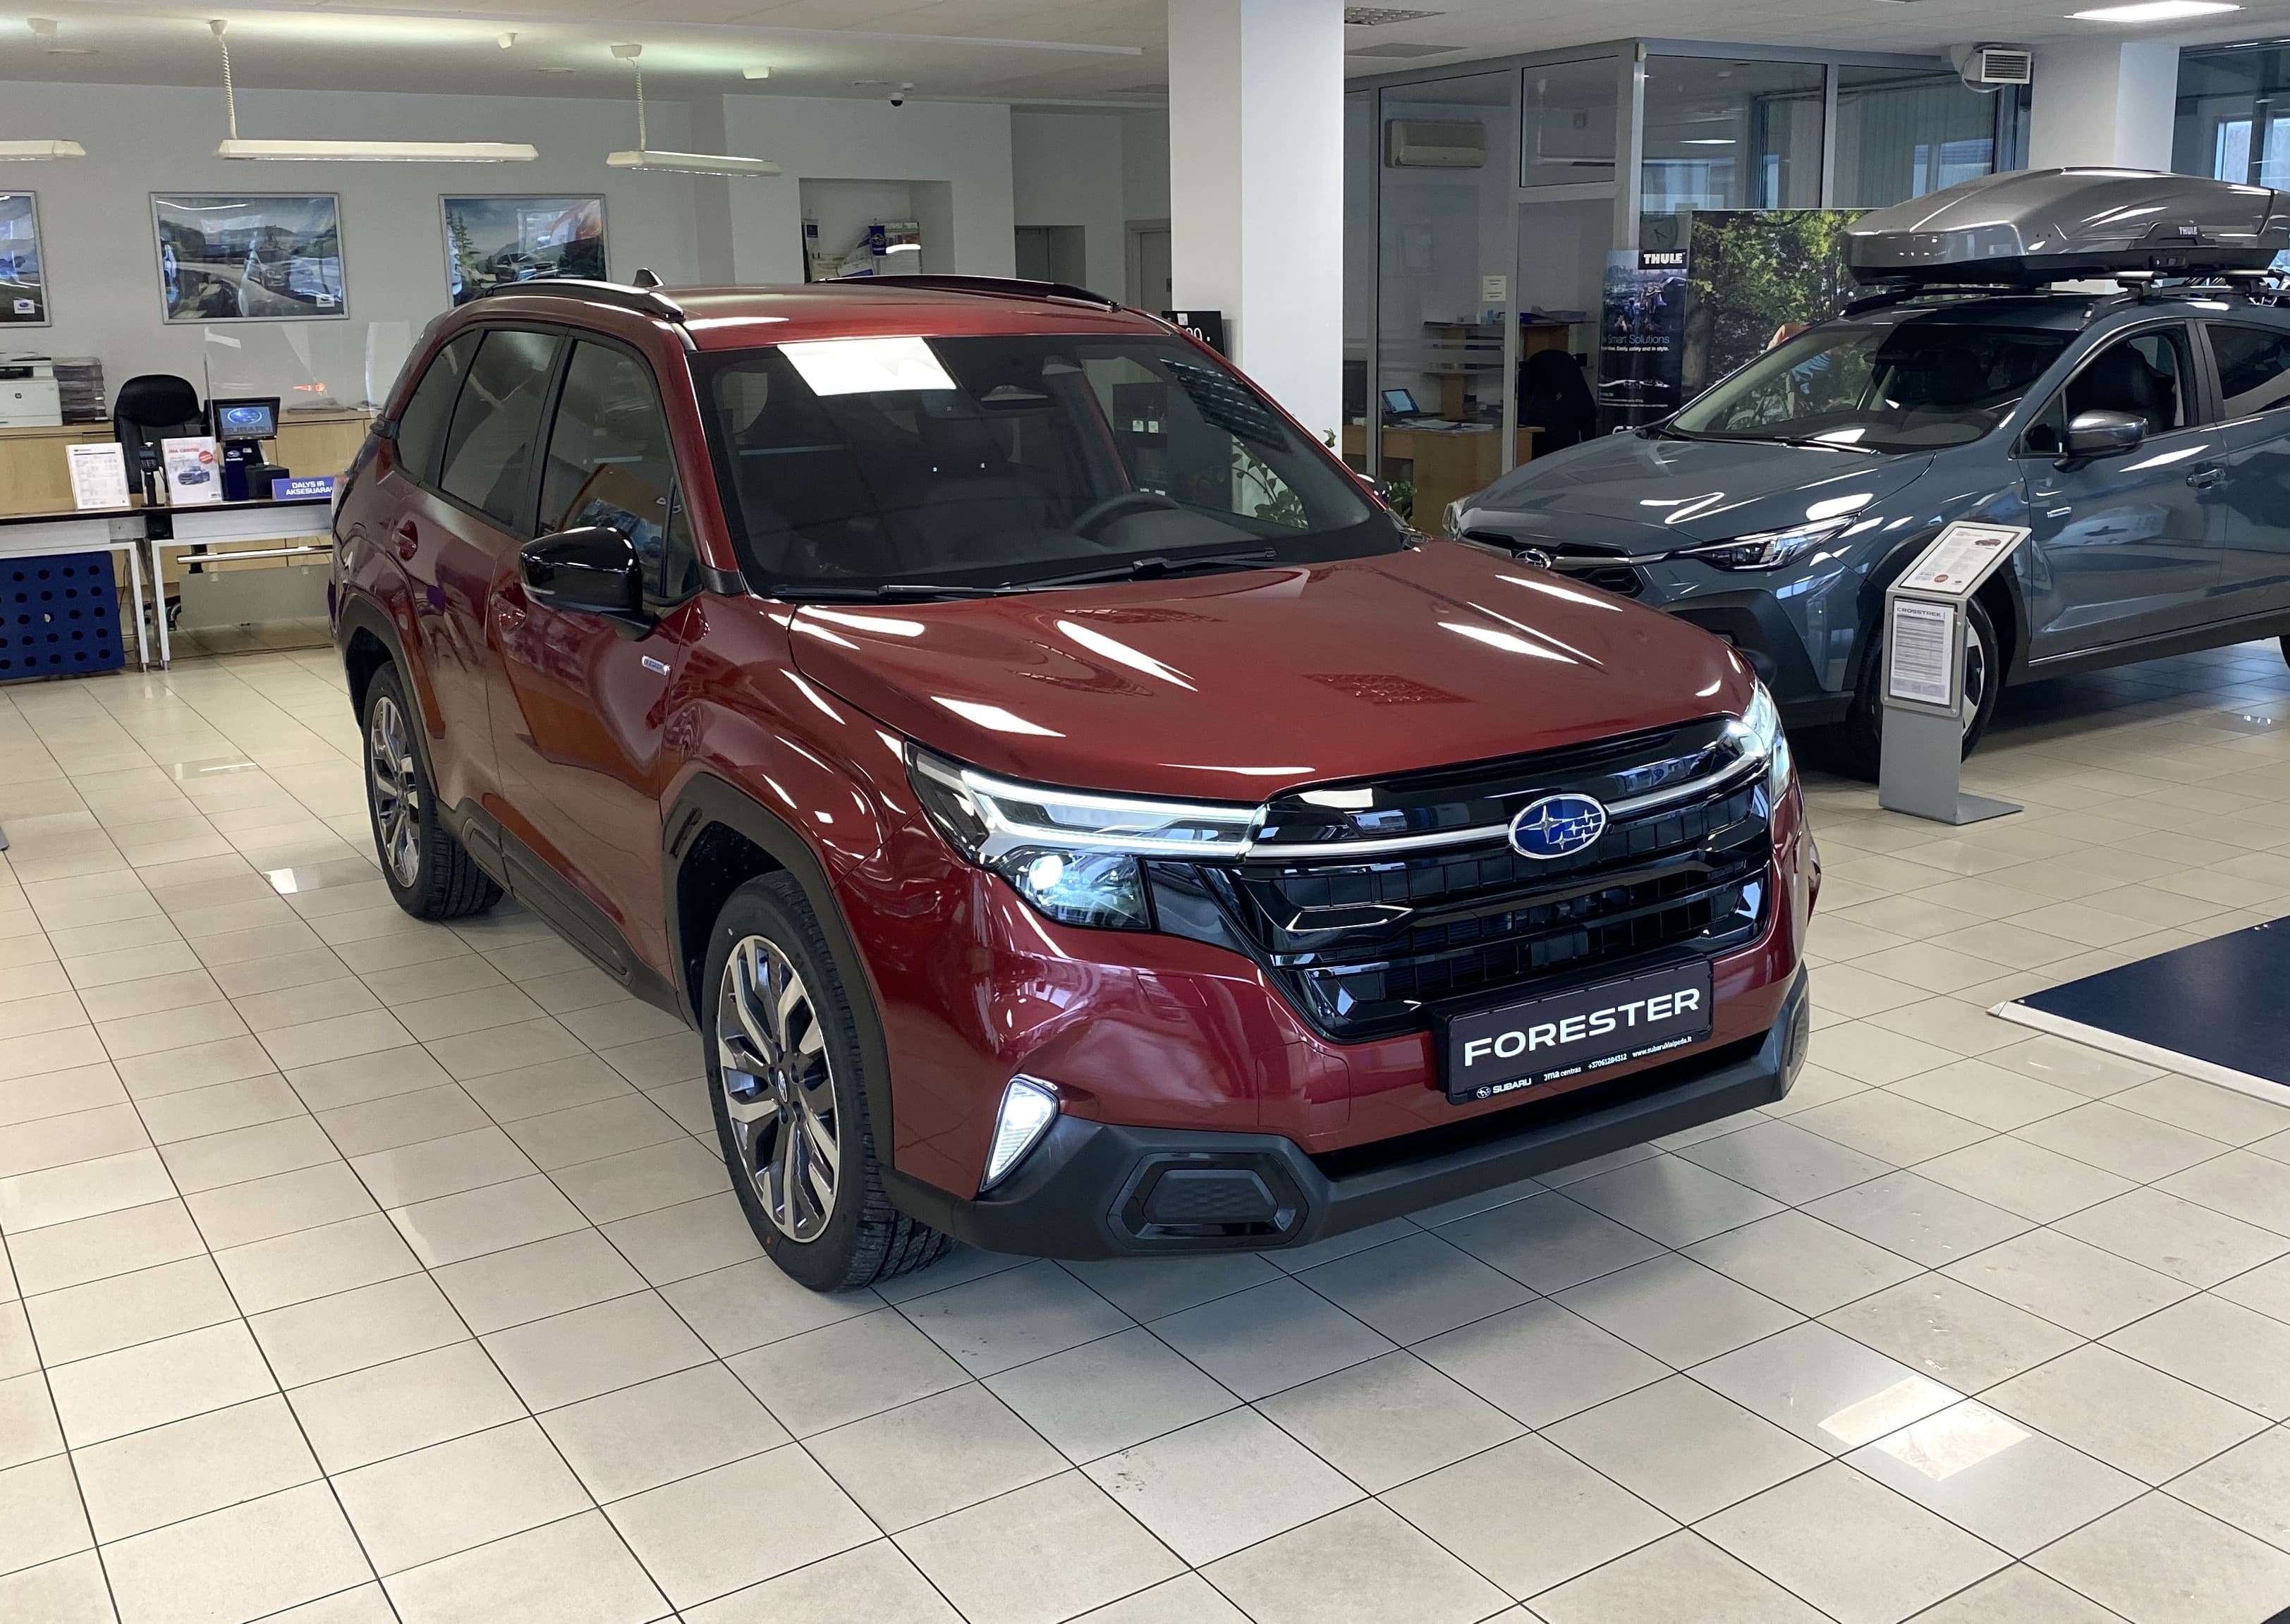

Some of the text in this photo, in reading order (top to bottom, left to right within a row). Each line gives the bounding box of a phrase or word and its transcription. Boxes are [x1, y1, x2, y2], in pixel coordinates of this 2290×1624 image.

[2179, 226, 2198, 235] THULE
[1643, 252, 1683, 264] THULE
[1629, 334, 1670, 344] Solutions
[1896, 607, 1942, 618] CROSSTREK
[1465, 988, 1700, 1067] FORESTER
[1493, 1077, 1532, 1093] SUBARU
